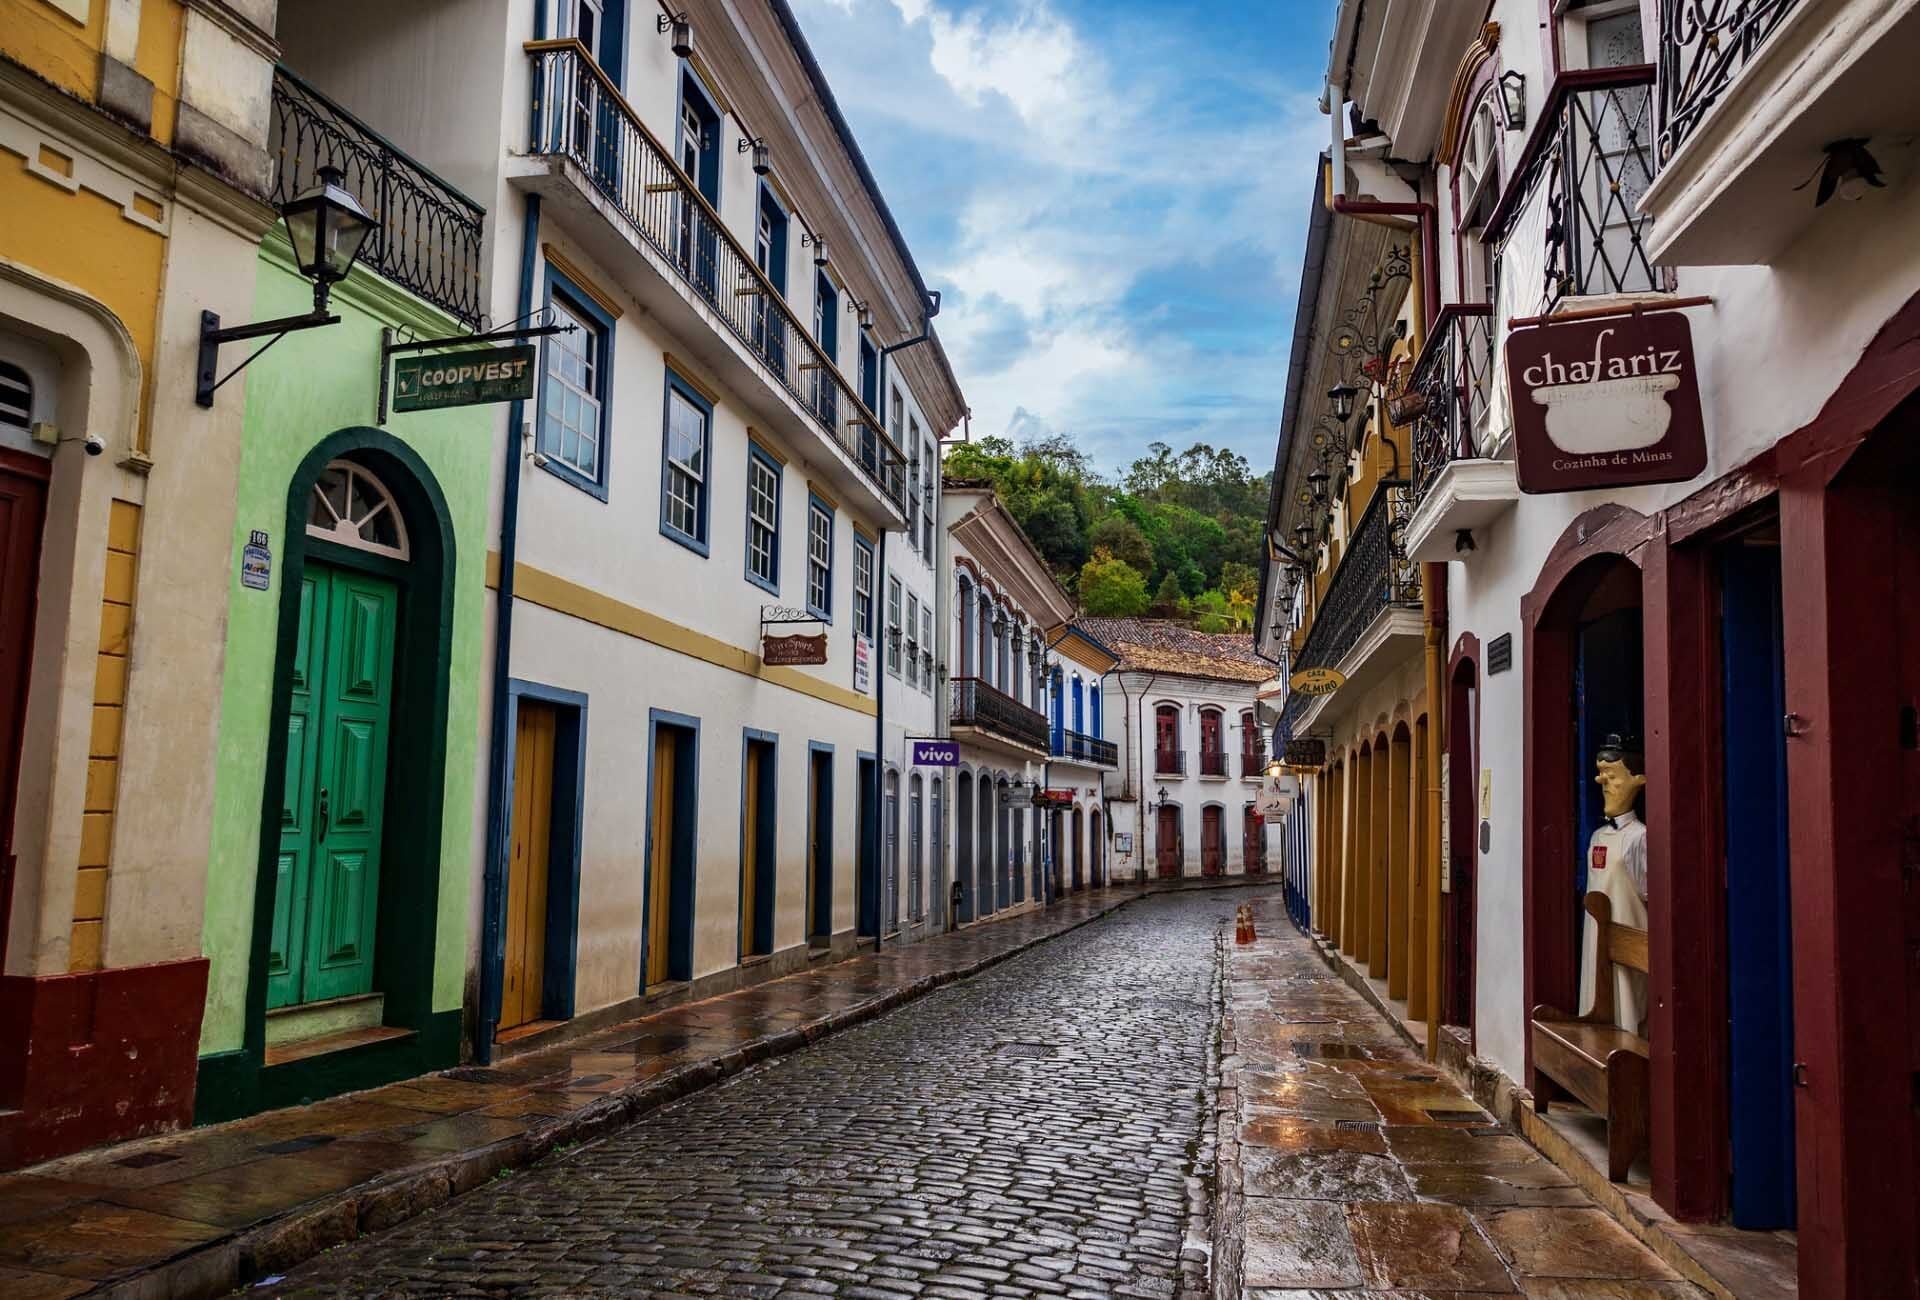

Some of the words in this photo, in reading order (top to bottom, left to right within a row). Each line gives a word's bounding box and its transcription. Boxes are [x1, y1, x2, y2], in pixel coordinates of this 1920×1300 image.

[1523, 328, 1682, 387] chafariz
[422, 359, 528, 386] COOPVEST
[1552, 454, 1607, 471] Cozinha
[1611, 453, 1628, 466] de
[1632, 451, 1673, 464] Minas
[1298, 680, 1338, 692] ALMIRO
[918, 746, 954, 762] vivo
